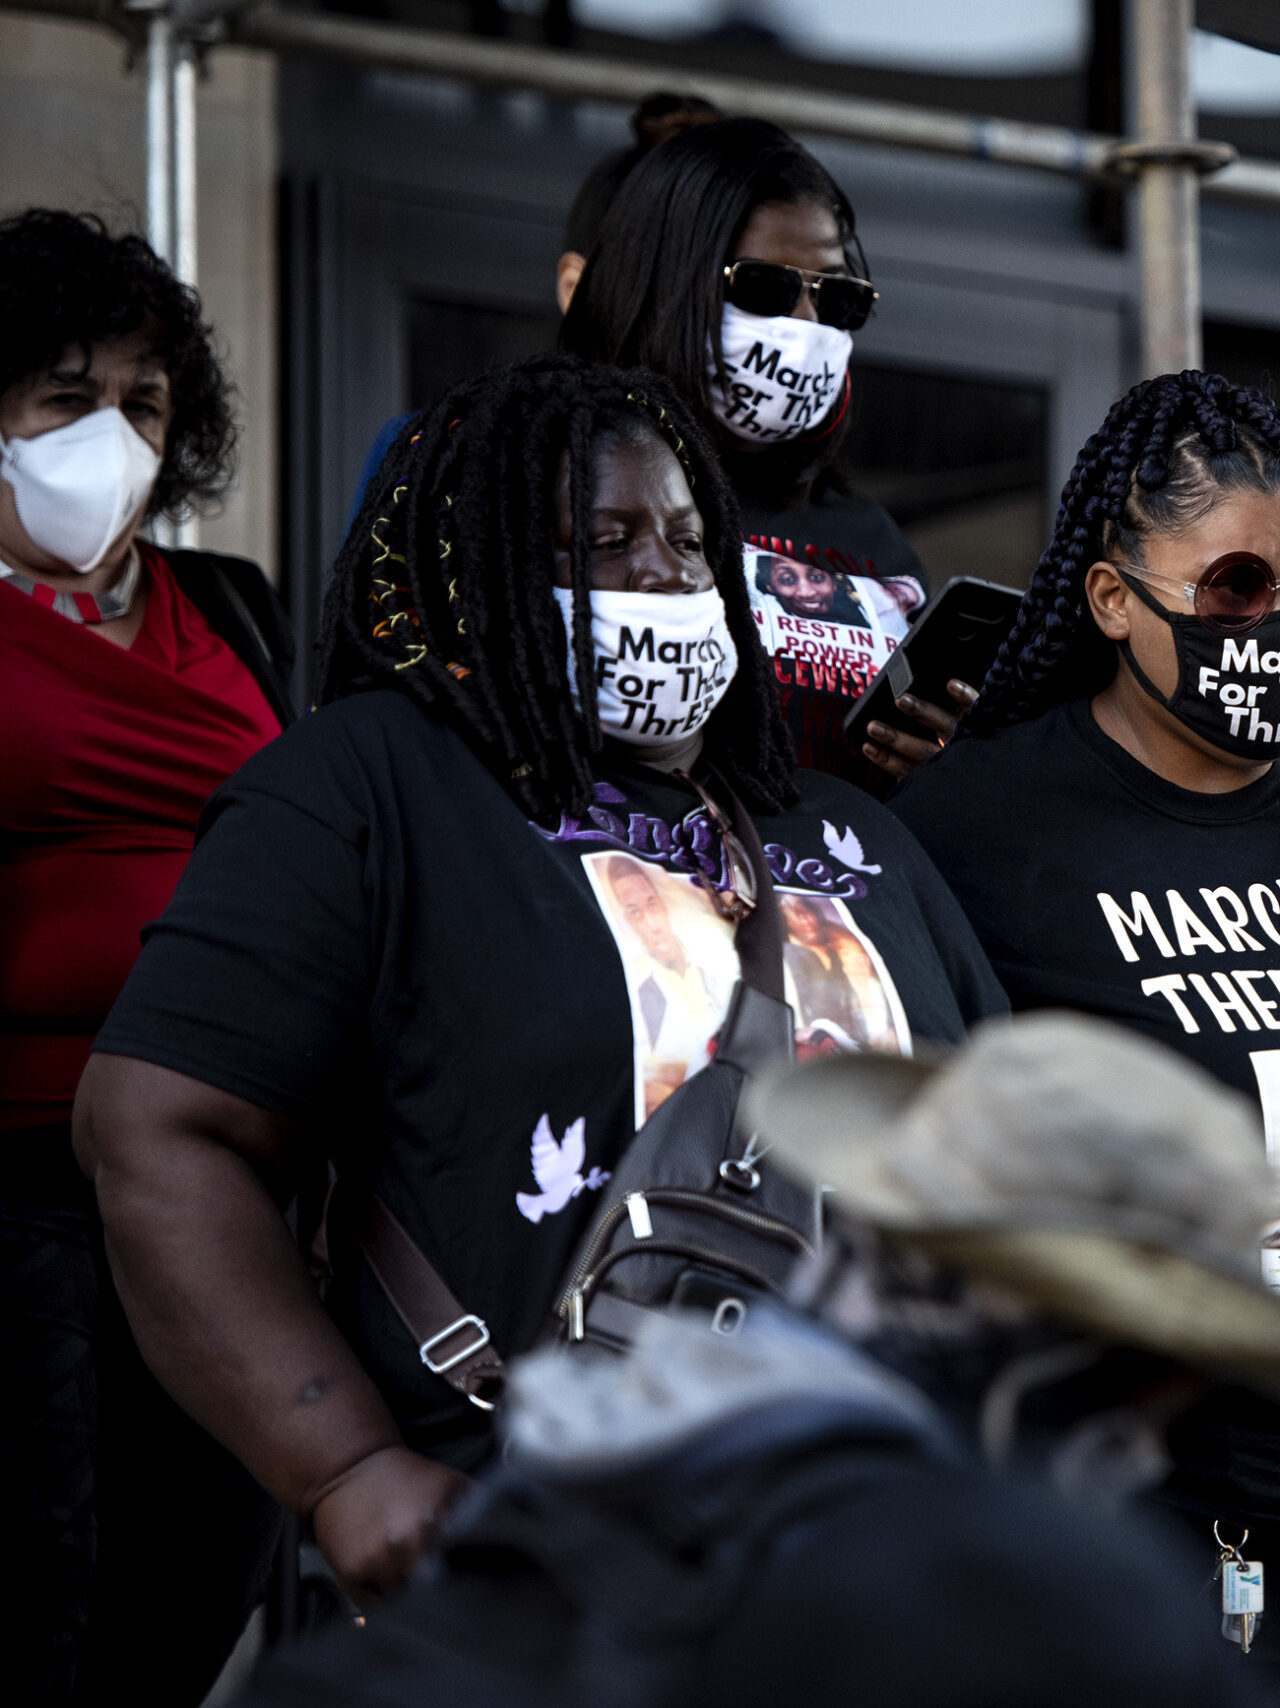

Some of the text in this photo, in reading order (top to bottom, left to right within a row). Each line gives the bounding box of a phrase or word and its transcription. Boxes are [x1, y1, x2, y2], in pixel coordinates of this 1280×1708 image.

[617, 626, 726, 664] March
[776, 615, 839, 641] REST
[849, 629, 874, 649] IN
[597, 655, 666, 701] For
[1198, 666, 1268, 707] For
